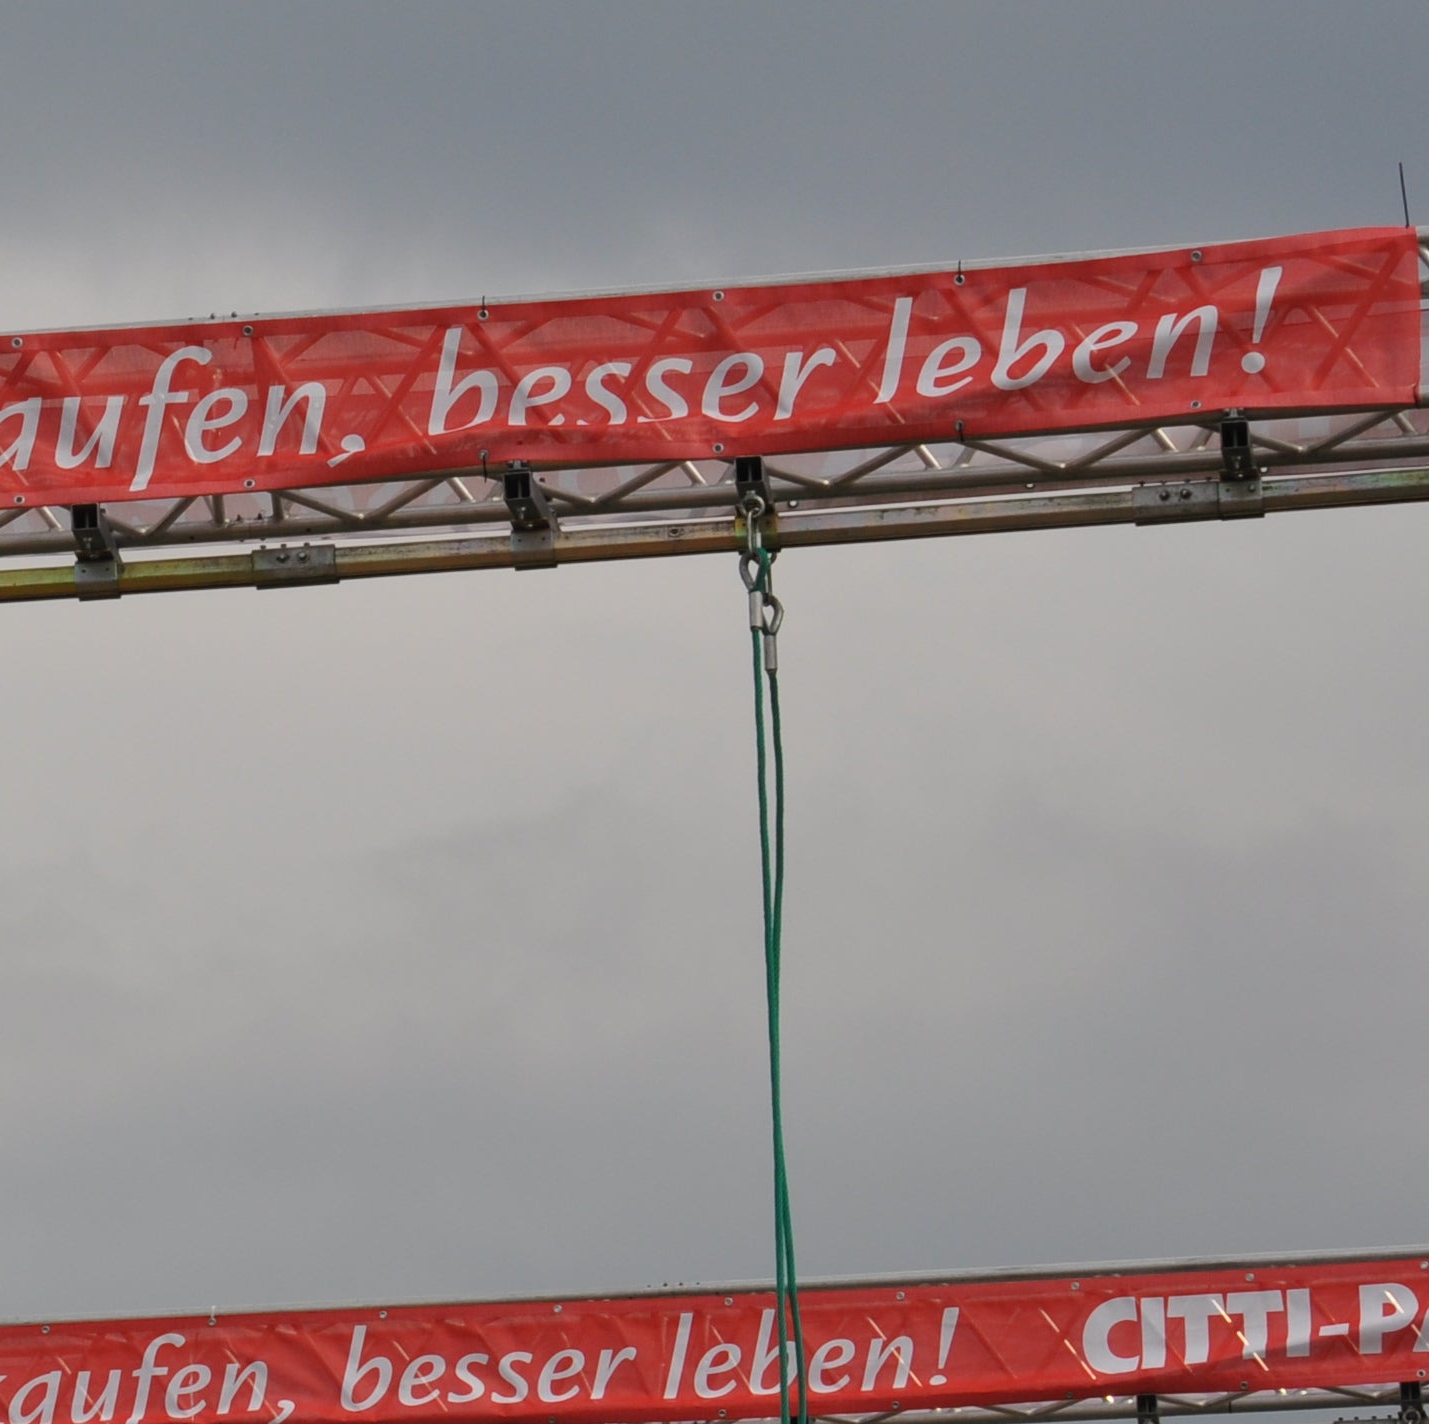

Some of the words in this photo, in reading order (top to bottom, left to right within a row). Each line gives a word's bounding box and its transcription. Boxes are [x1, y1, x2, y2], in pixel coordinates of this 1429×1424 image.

[428, 326, 838, 435] besser
[875, 265, 1283, 403] leben!
[340, 1324, 638, 1411] besser
[664, 1307, 960, 1399] leben!
[1082, 1282, 1429, 1374] CITTI-P
